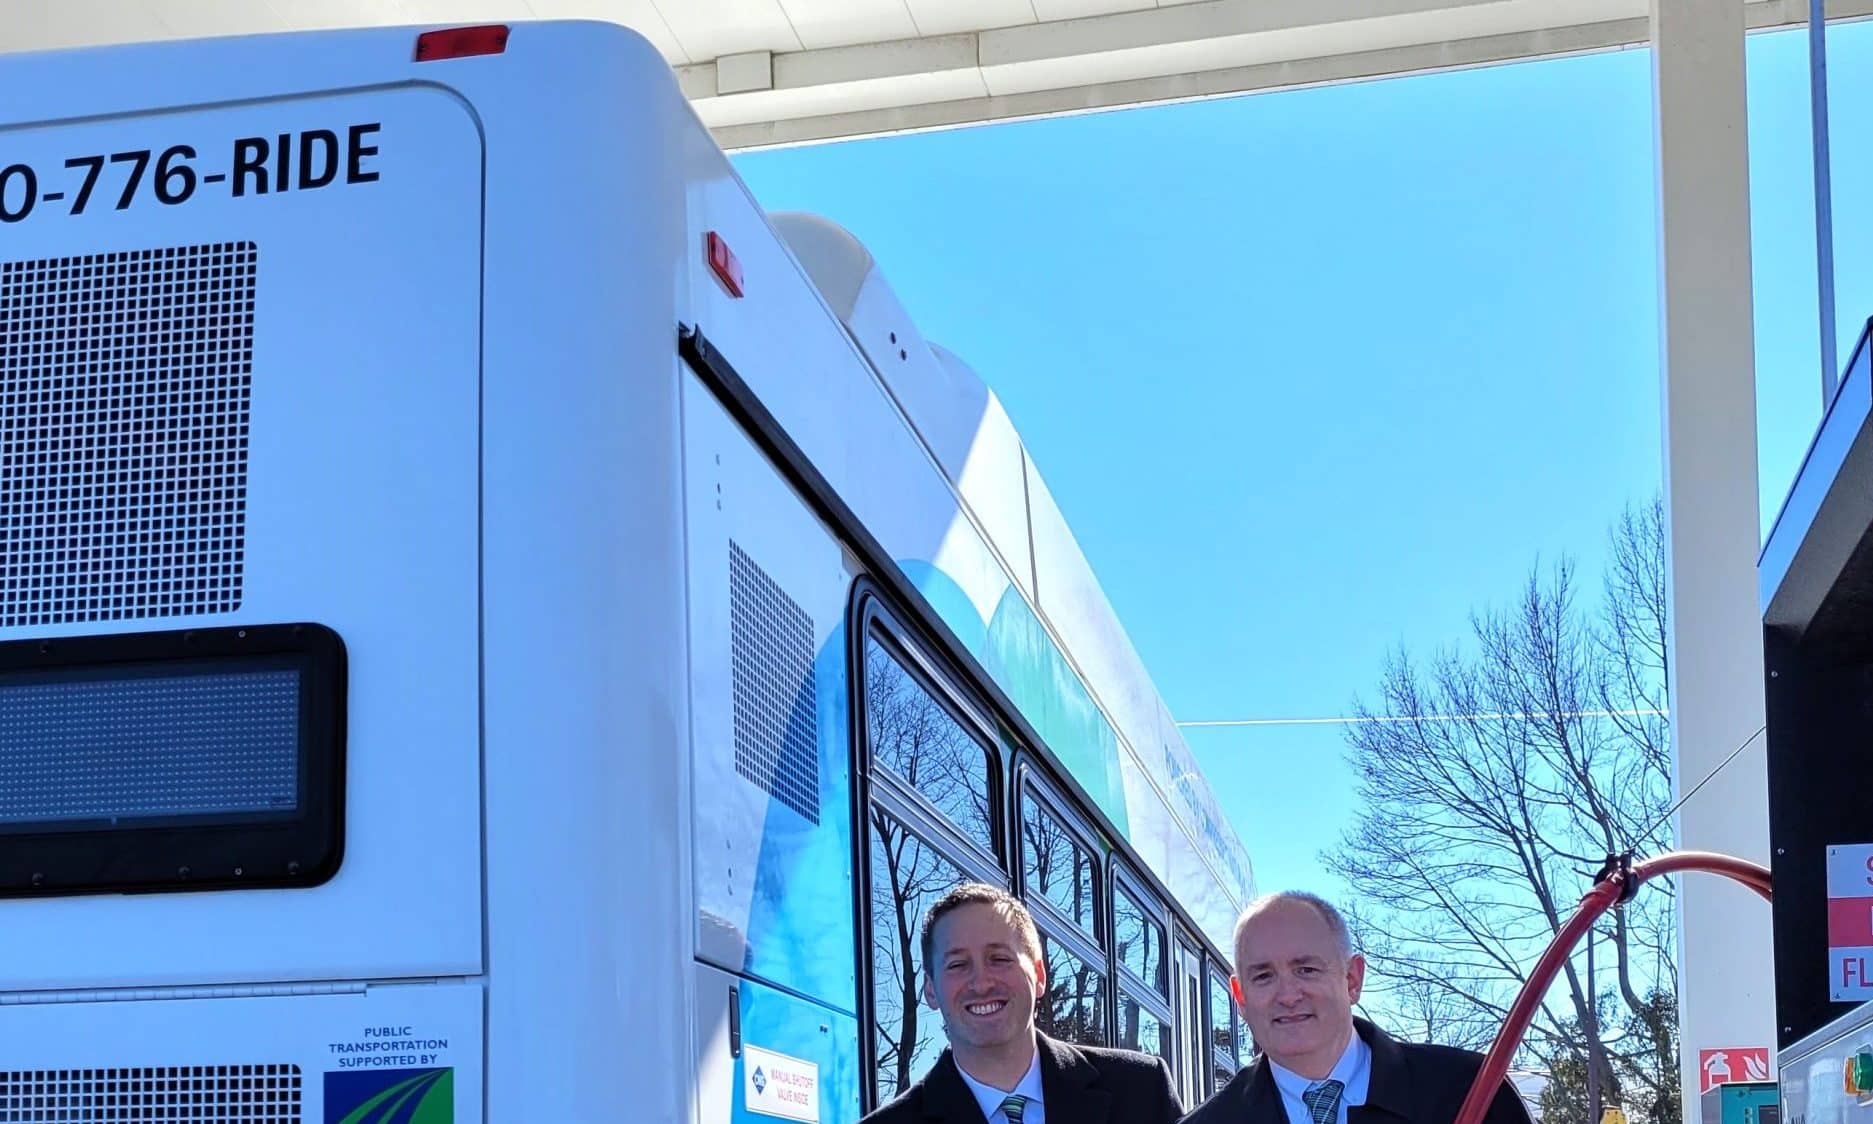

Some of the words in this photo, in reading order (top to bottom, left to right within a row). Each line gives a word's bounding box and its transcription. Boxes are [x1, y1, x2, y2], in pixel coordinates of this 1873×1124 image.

[364, 1026, 412, 1037] PUBLIC
[329, 1039, 448, 1053] TRANSPORTATION
[338, 1055, 417, 1067] SUPPORTED
[420, 1054, 438, 1064] BY
